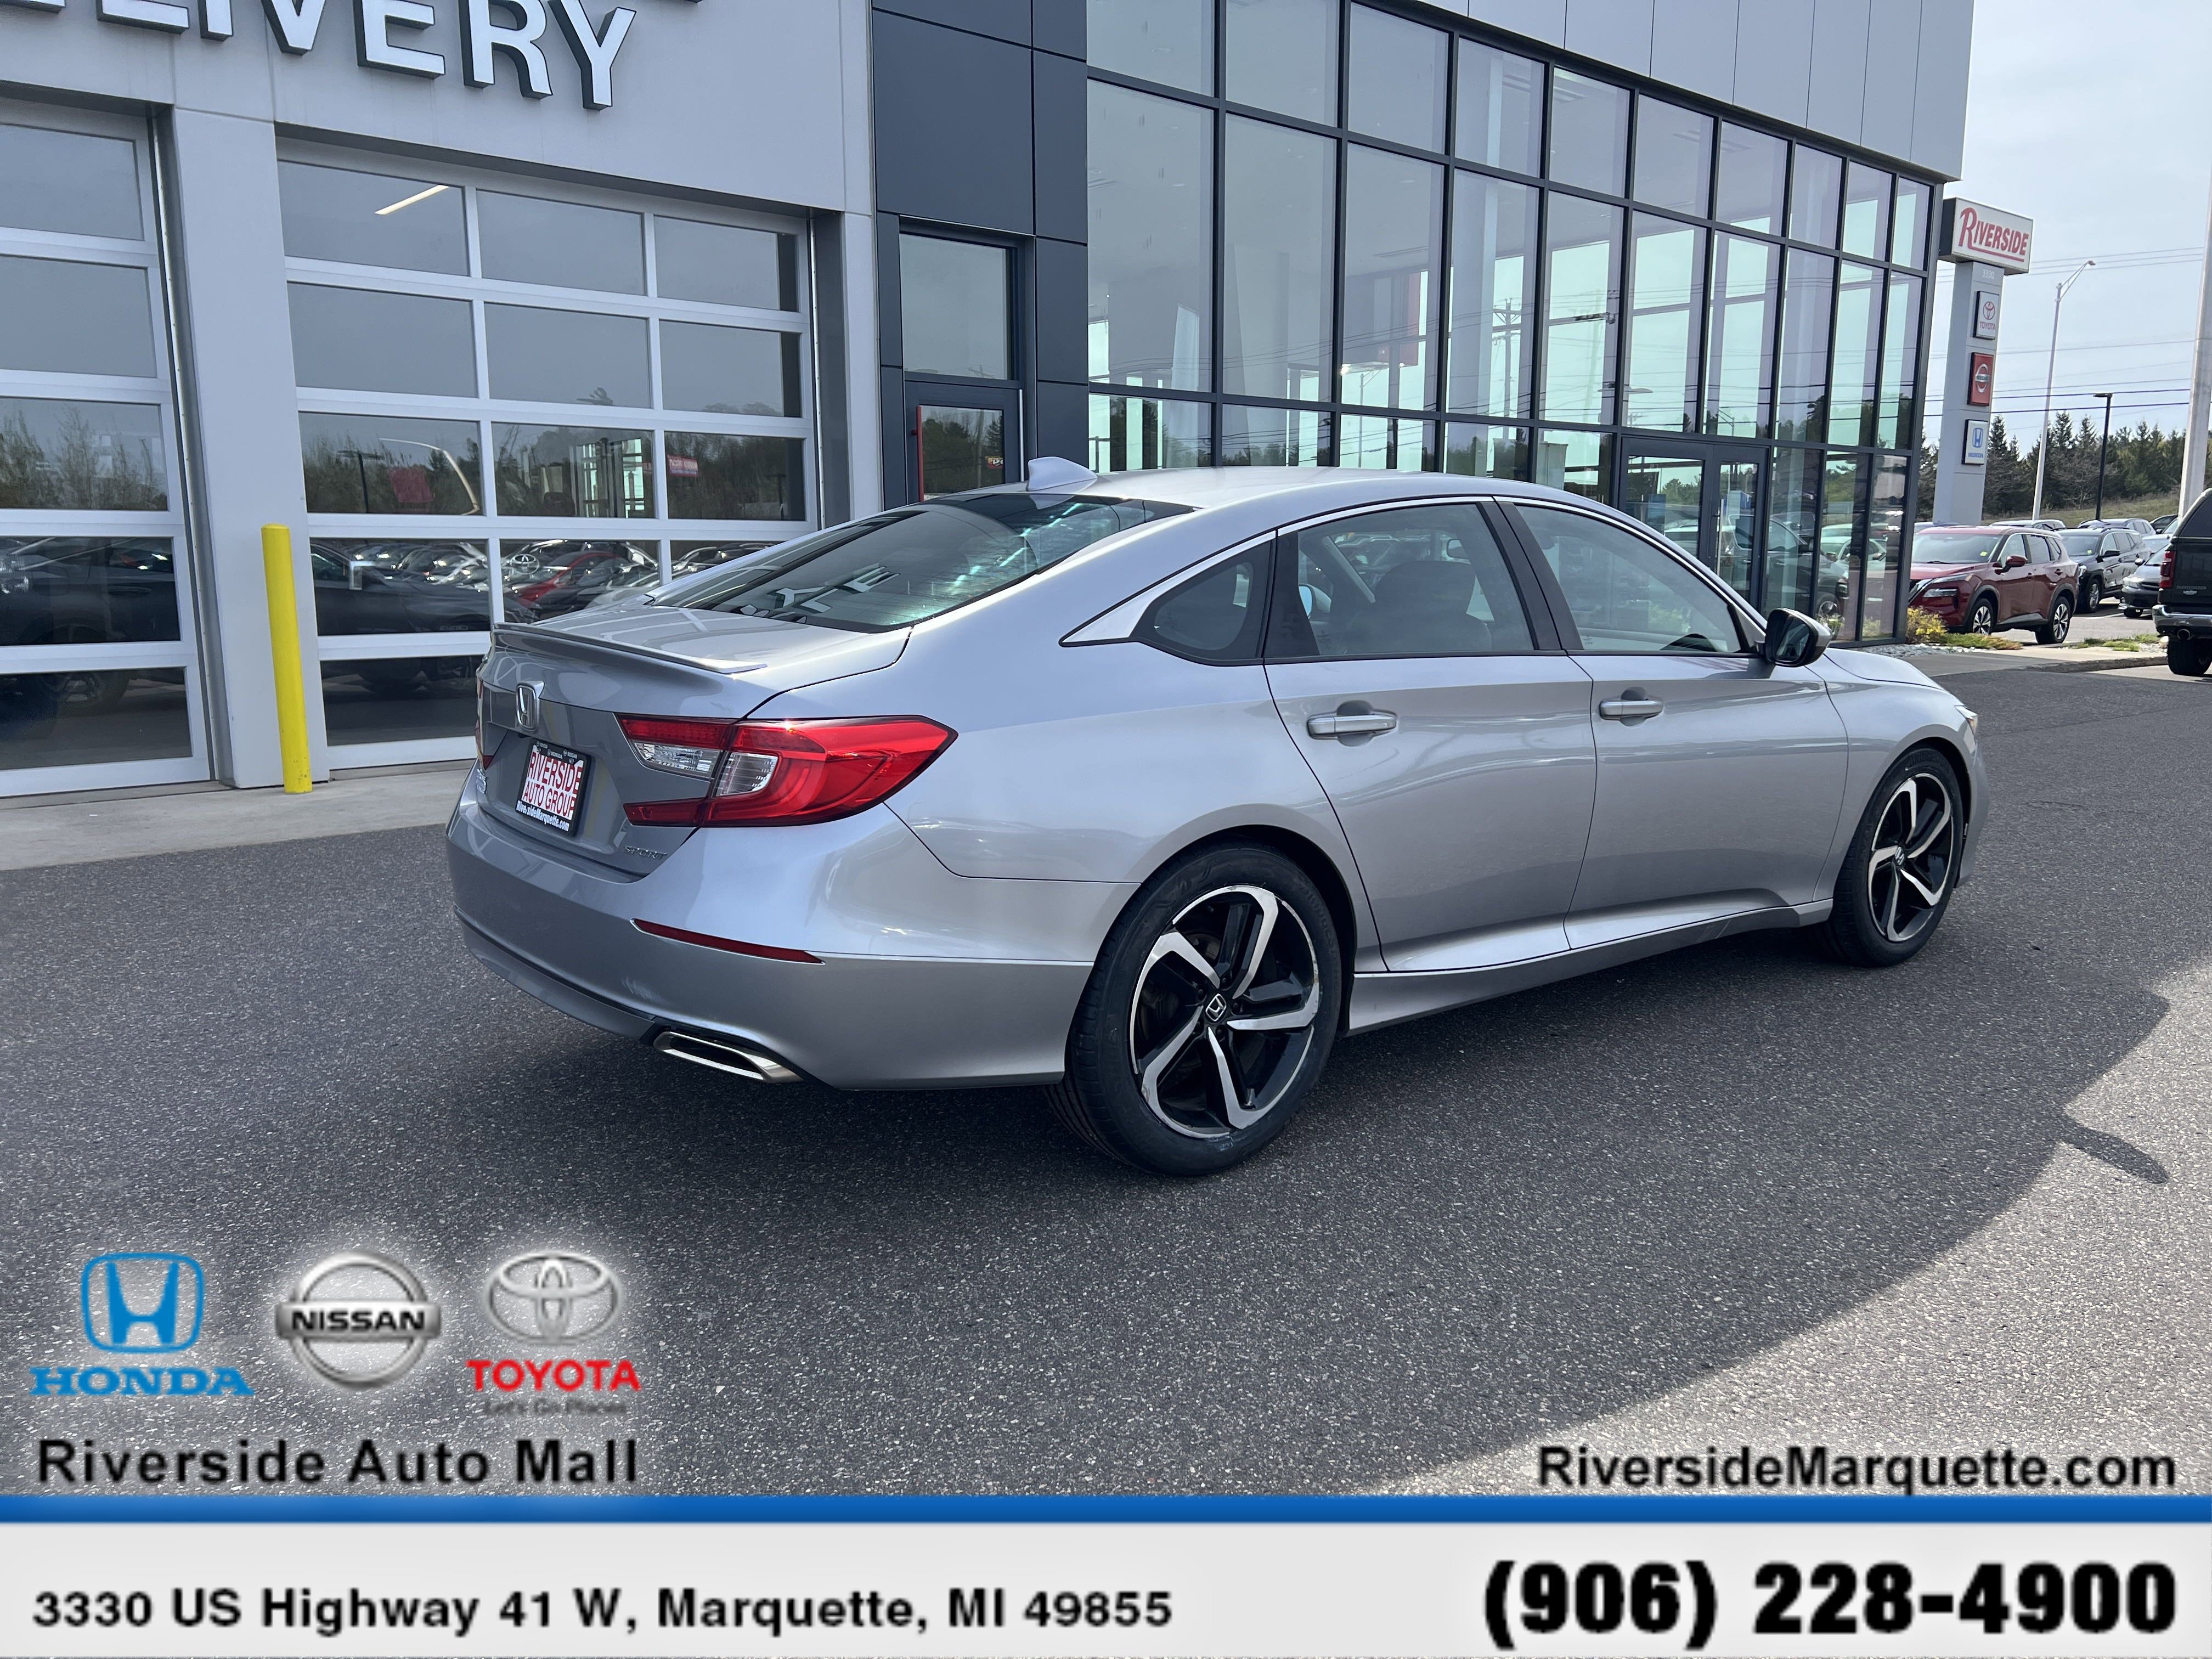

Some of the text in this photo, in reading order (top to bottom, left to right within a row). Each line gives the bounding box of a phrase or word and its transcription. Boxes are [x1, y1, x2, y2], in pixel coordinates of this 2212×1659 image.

[1958, 207, 2029, 257] RIVERSIDE
[1979, 321, 1996, 330] TOYOTA
[528, 752, 584, 795] RIVERSIDE
[516, 800, 570, 832] RivesideMarquette.com
[523, 781, 577, 818] AUTO GROUP
